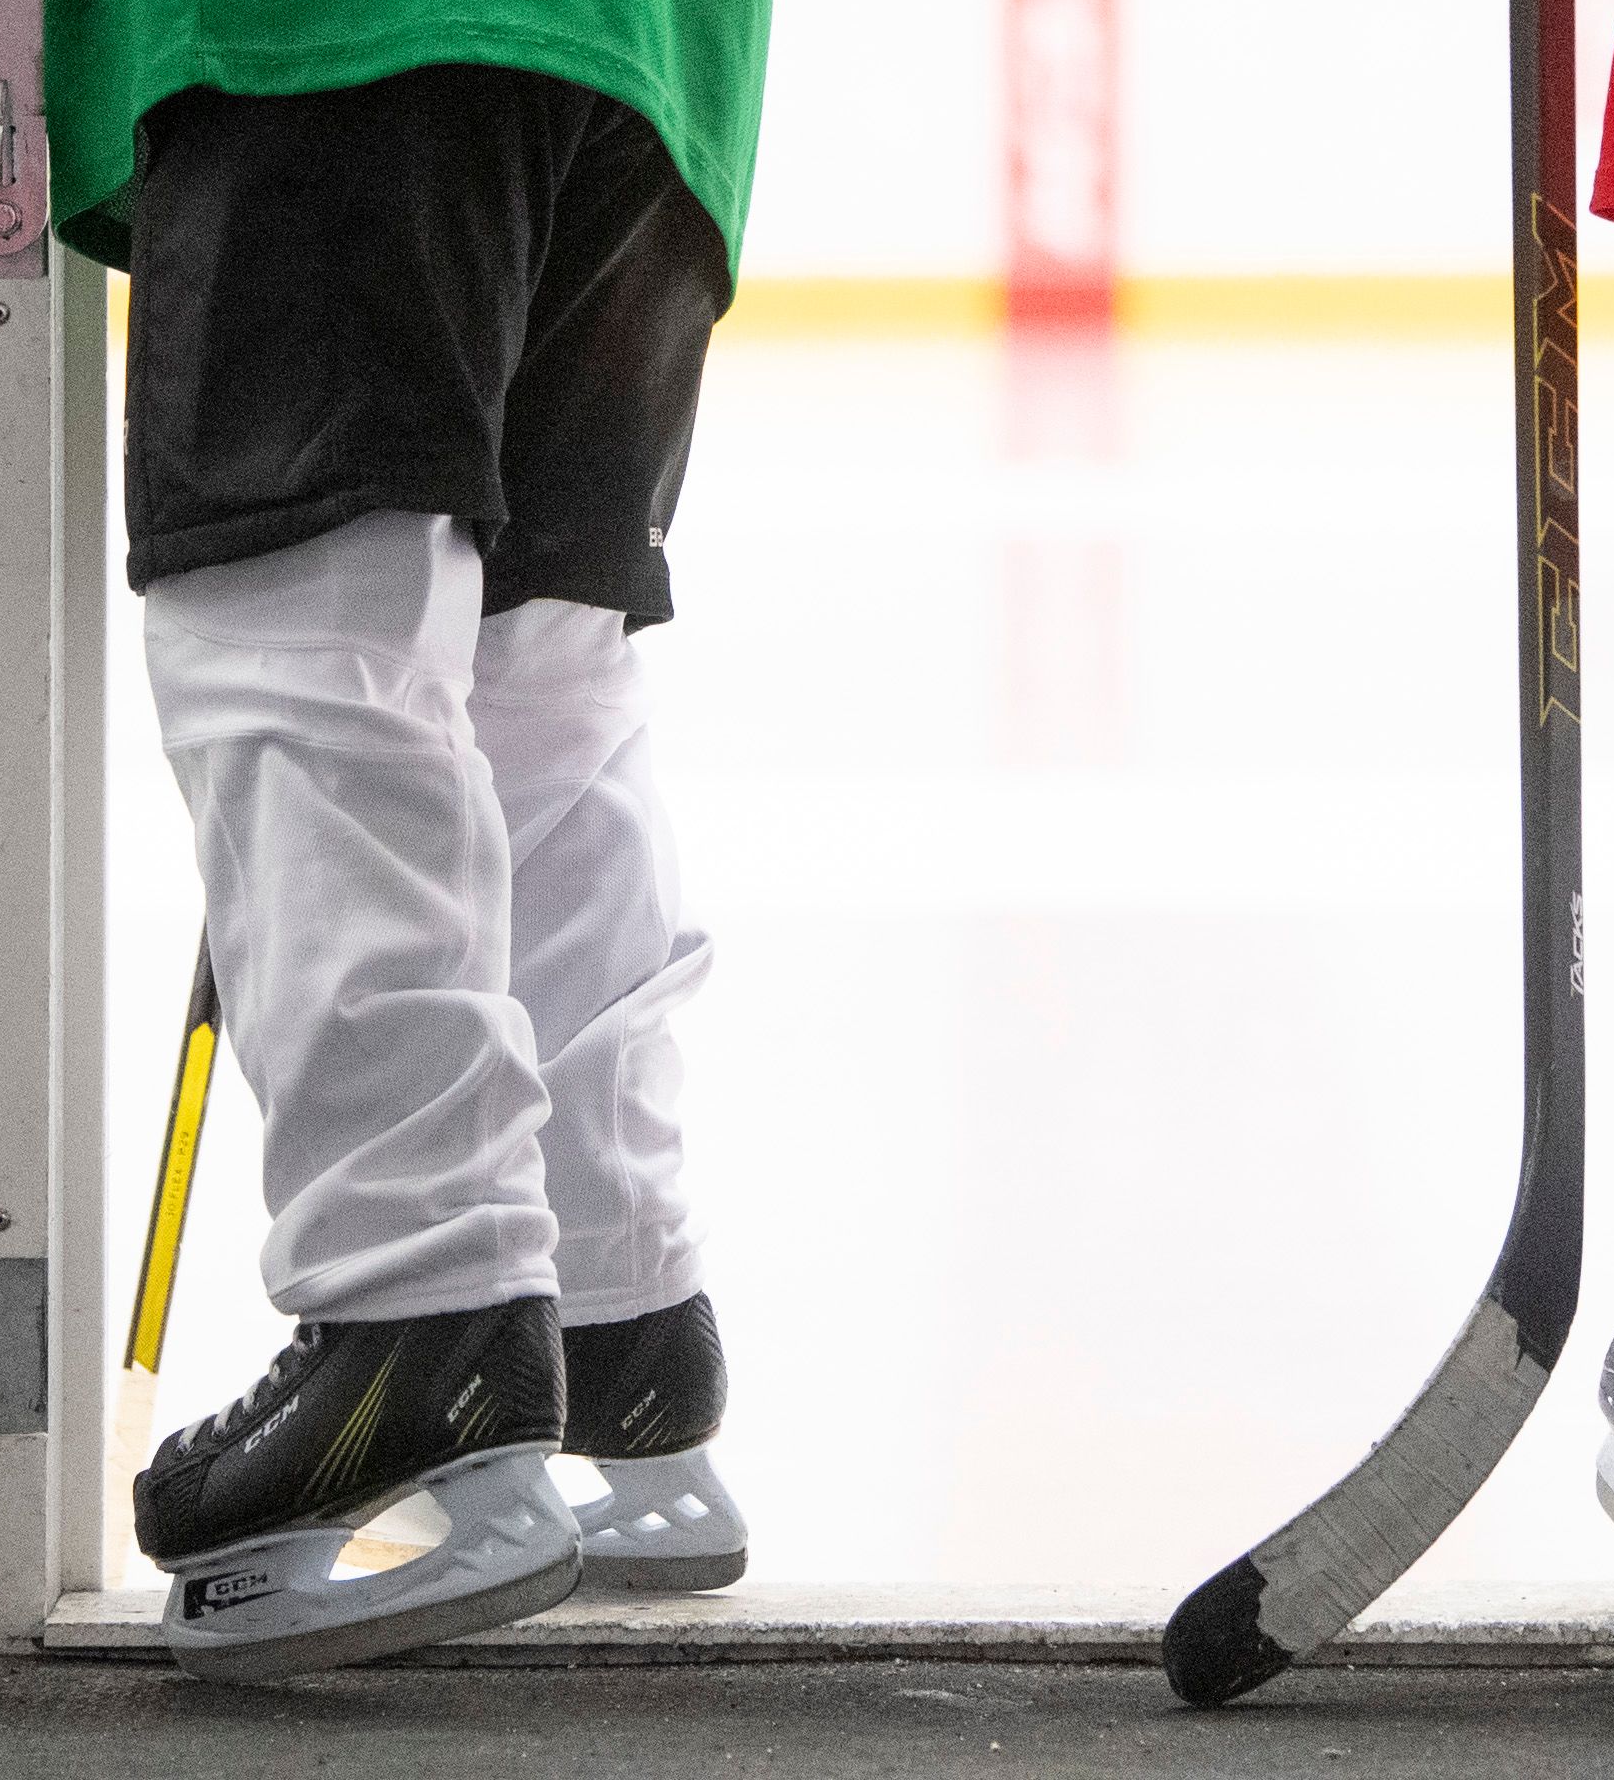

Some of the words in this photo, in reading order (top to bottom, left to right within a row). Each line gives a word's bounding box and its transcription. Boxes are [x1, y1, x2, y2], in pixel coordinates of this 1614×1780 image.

[1569, 890, 1585, 998] TACKS
[244, 1395, 299, 1454] CCM
[448, 1373, 482, 1424] CCM
[619, 1388, 657, 1431] CCM
